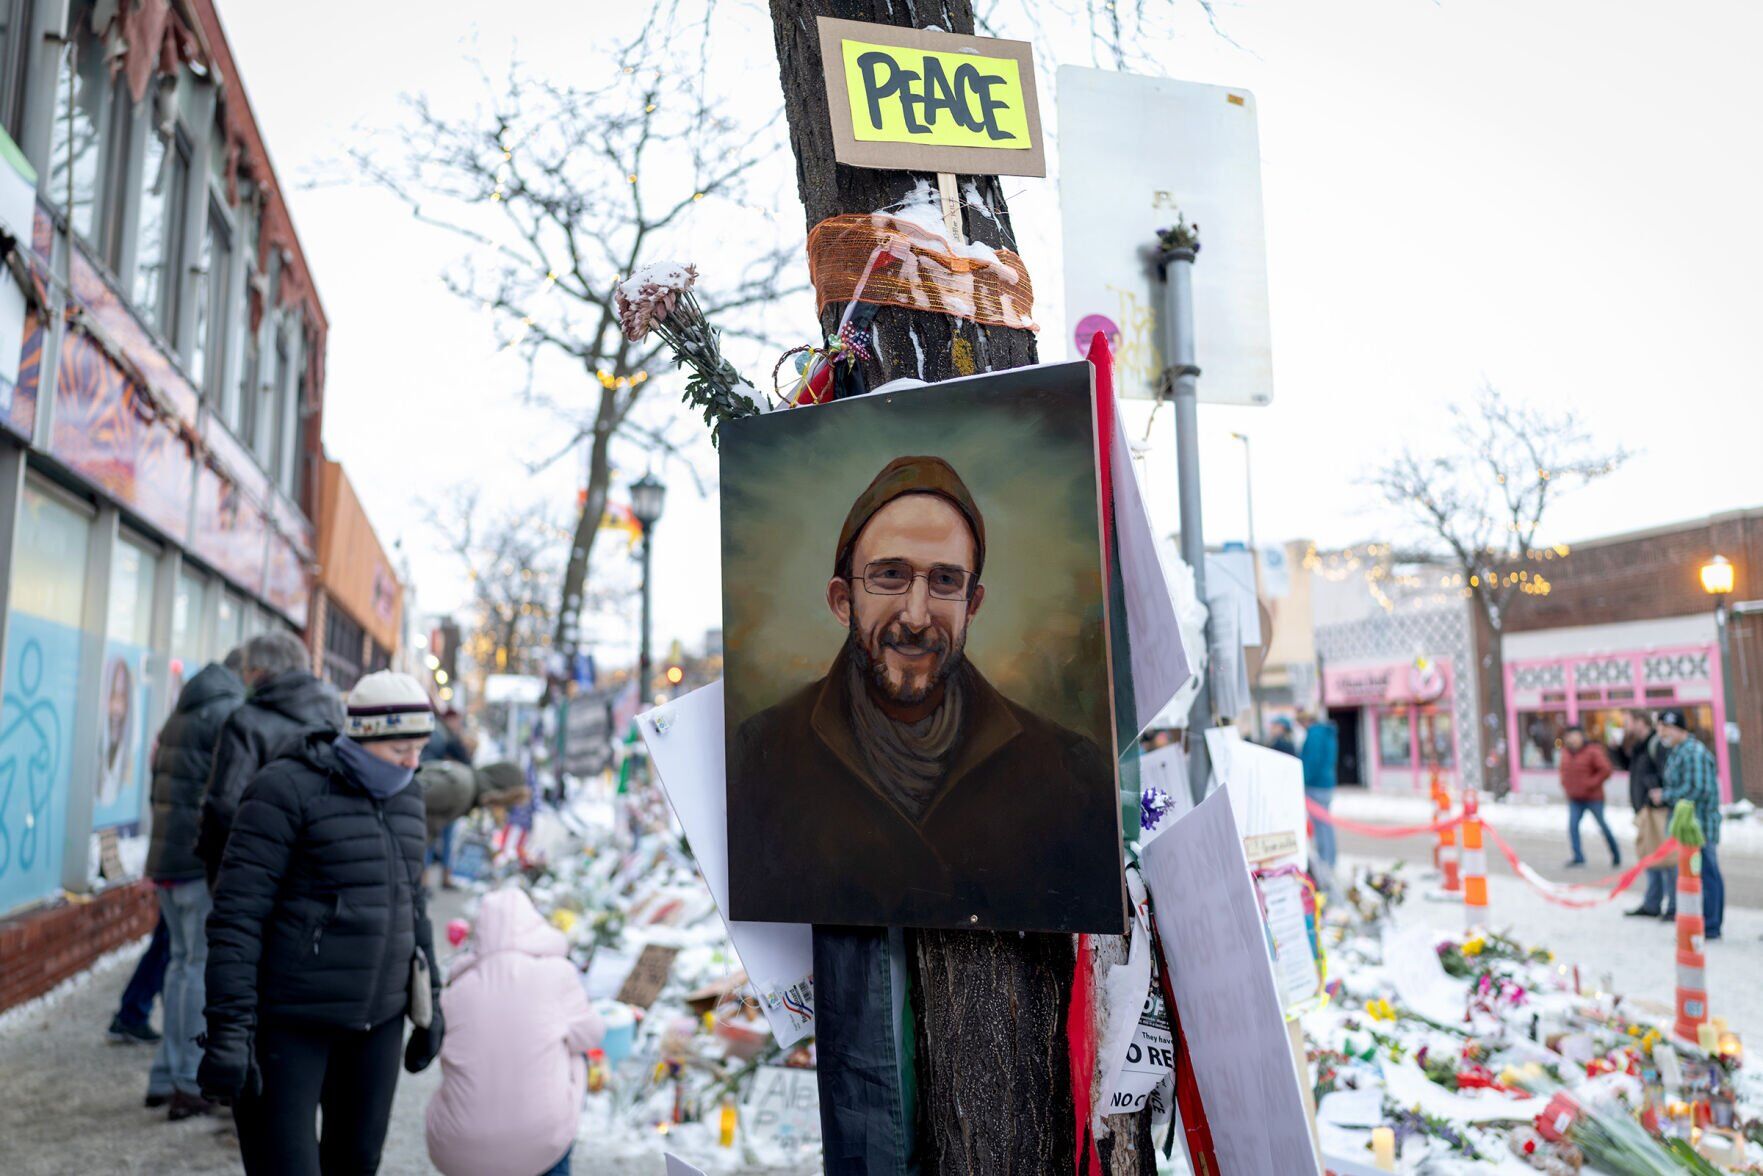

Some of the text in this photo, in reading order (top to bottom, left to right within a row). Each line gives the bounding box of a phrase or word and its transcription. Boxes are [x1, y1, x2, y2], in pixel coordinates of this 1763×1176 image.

[857, 51, 1016, 141] PEACE
[1142, 1031, 1173, 1045] They hav
[1110, 1092, 1133, 1107] NO
